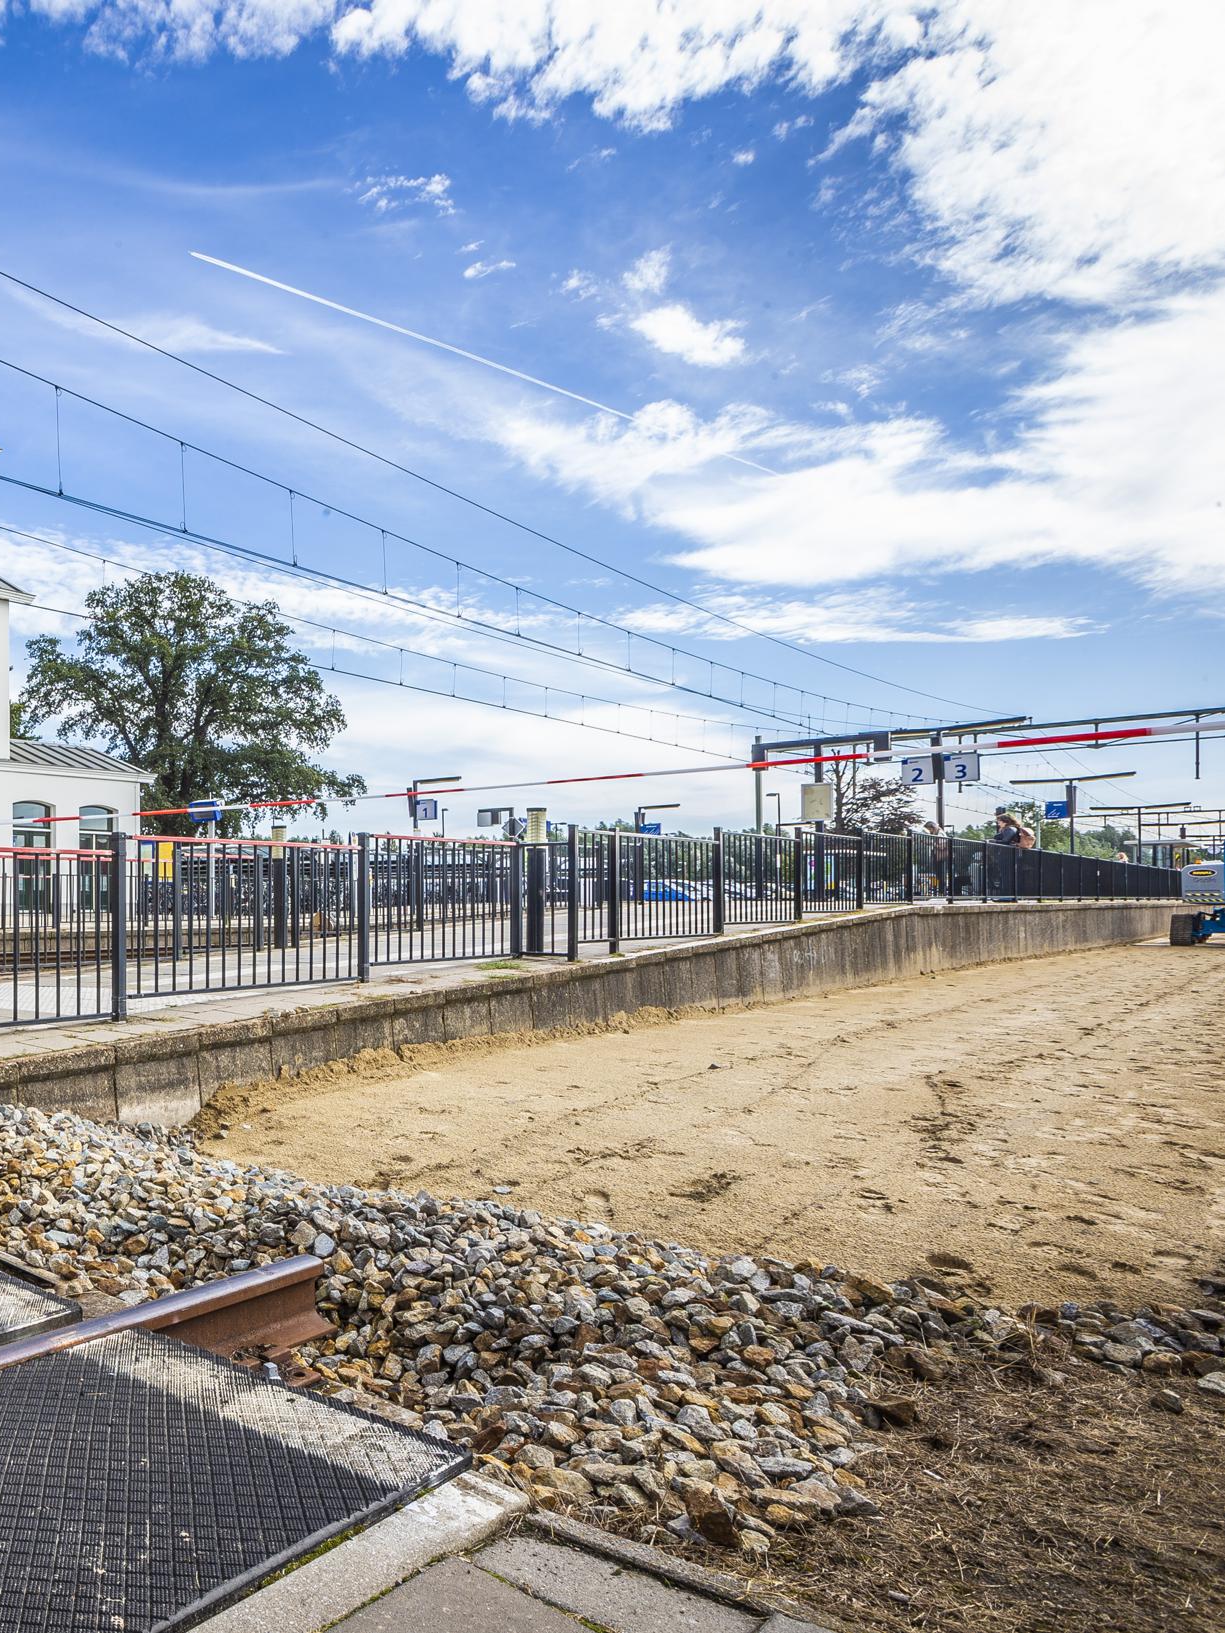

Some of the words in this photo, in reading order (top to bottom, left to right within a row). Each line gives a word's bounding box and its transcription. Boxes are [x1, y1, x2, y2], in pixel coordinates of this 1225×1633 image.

[911, 767, 924, 782] 2
[954, 763, 967, 779] 3
[422, 807, 428, 818] 1
